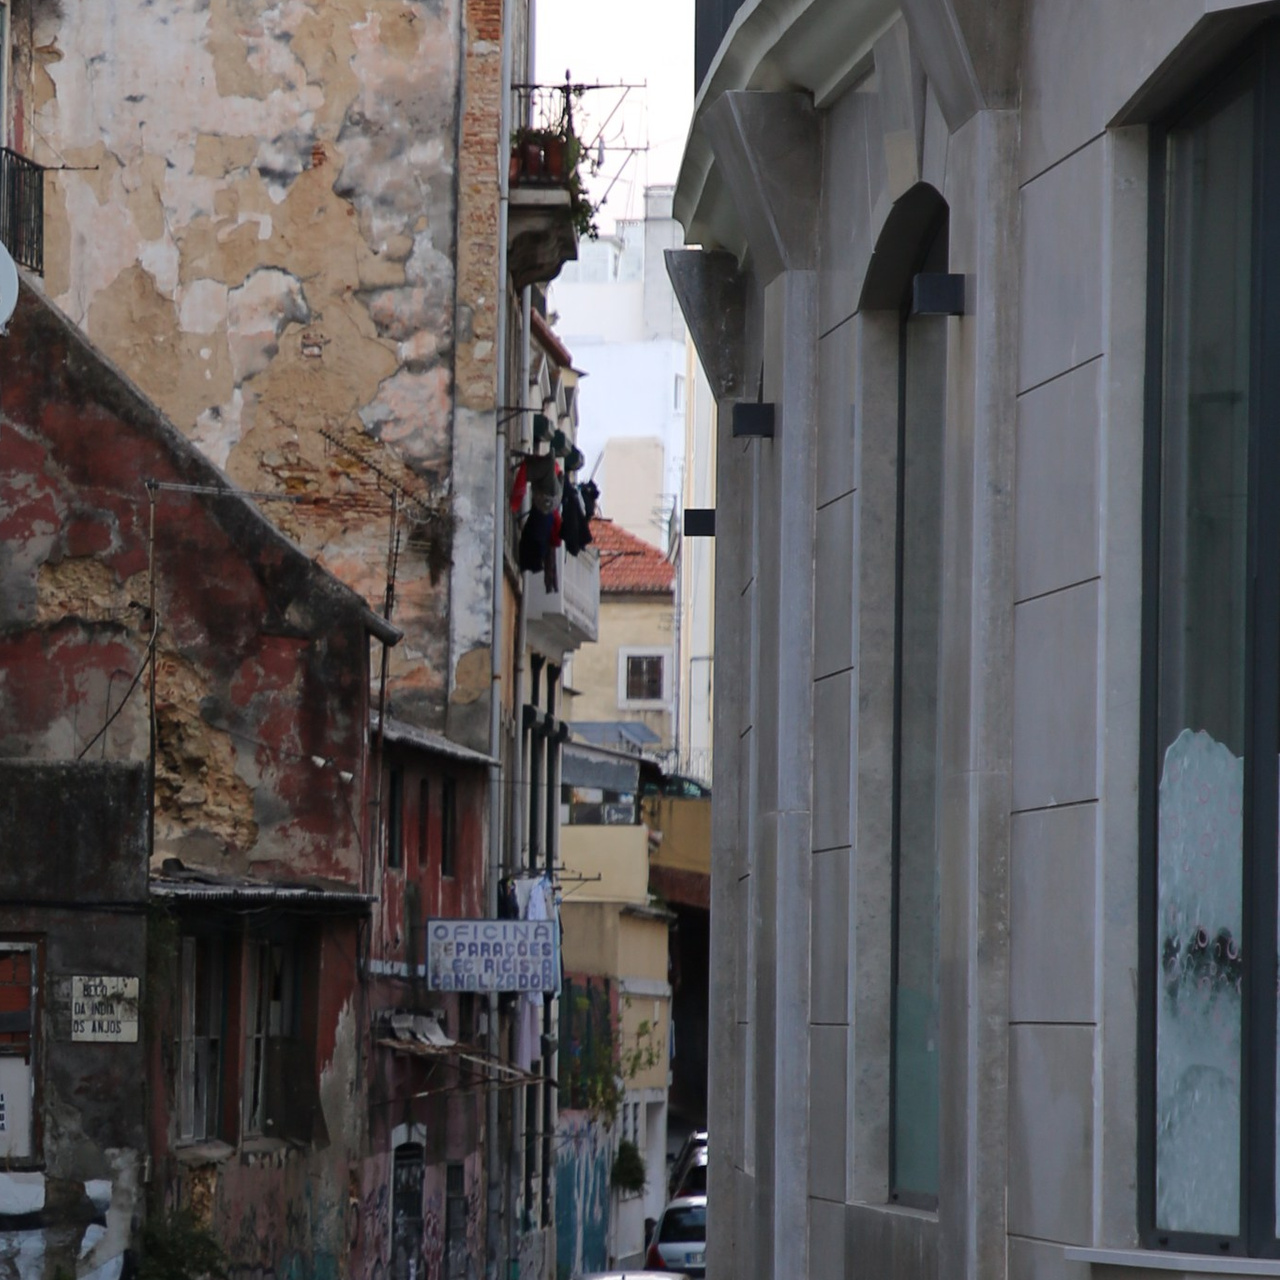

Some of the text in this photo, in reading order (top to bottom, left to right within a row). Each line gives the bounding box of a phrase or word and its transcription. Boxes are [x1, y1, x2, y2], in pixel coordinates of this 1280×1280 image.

[433, 924, 550, 940] OFICINA
[74, 1002, 86, 1015] DA
[91, 1020, 122, 1034] ANJOS
